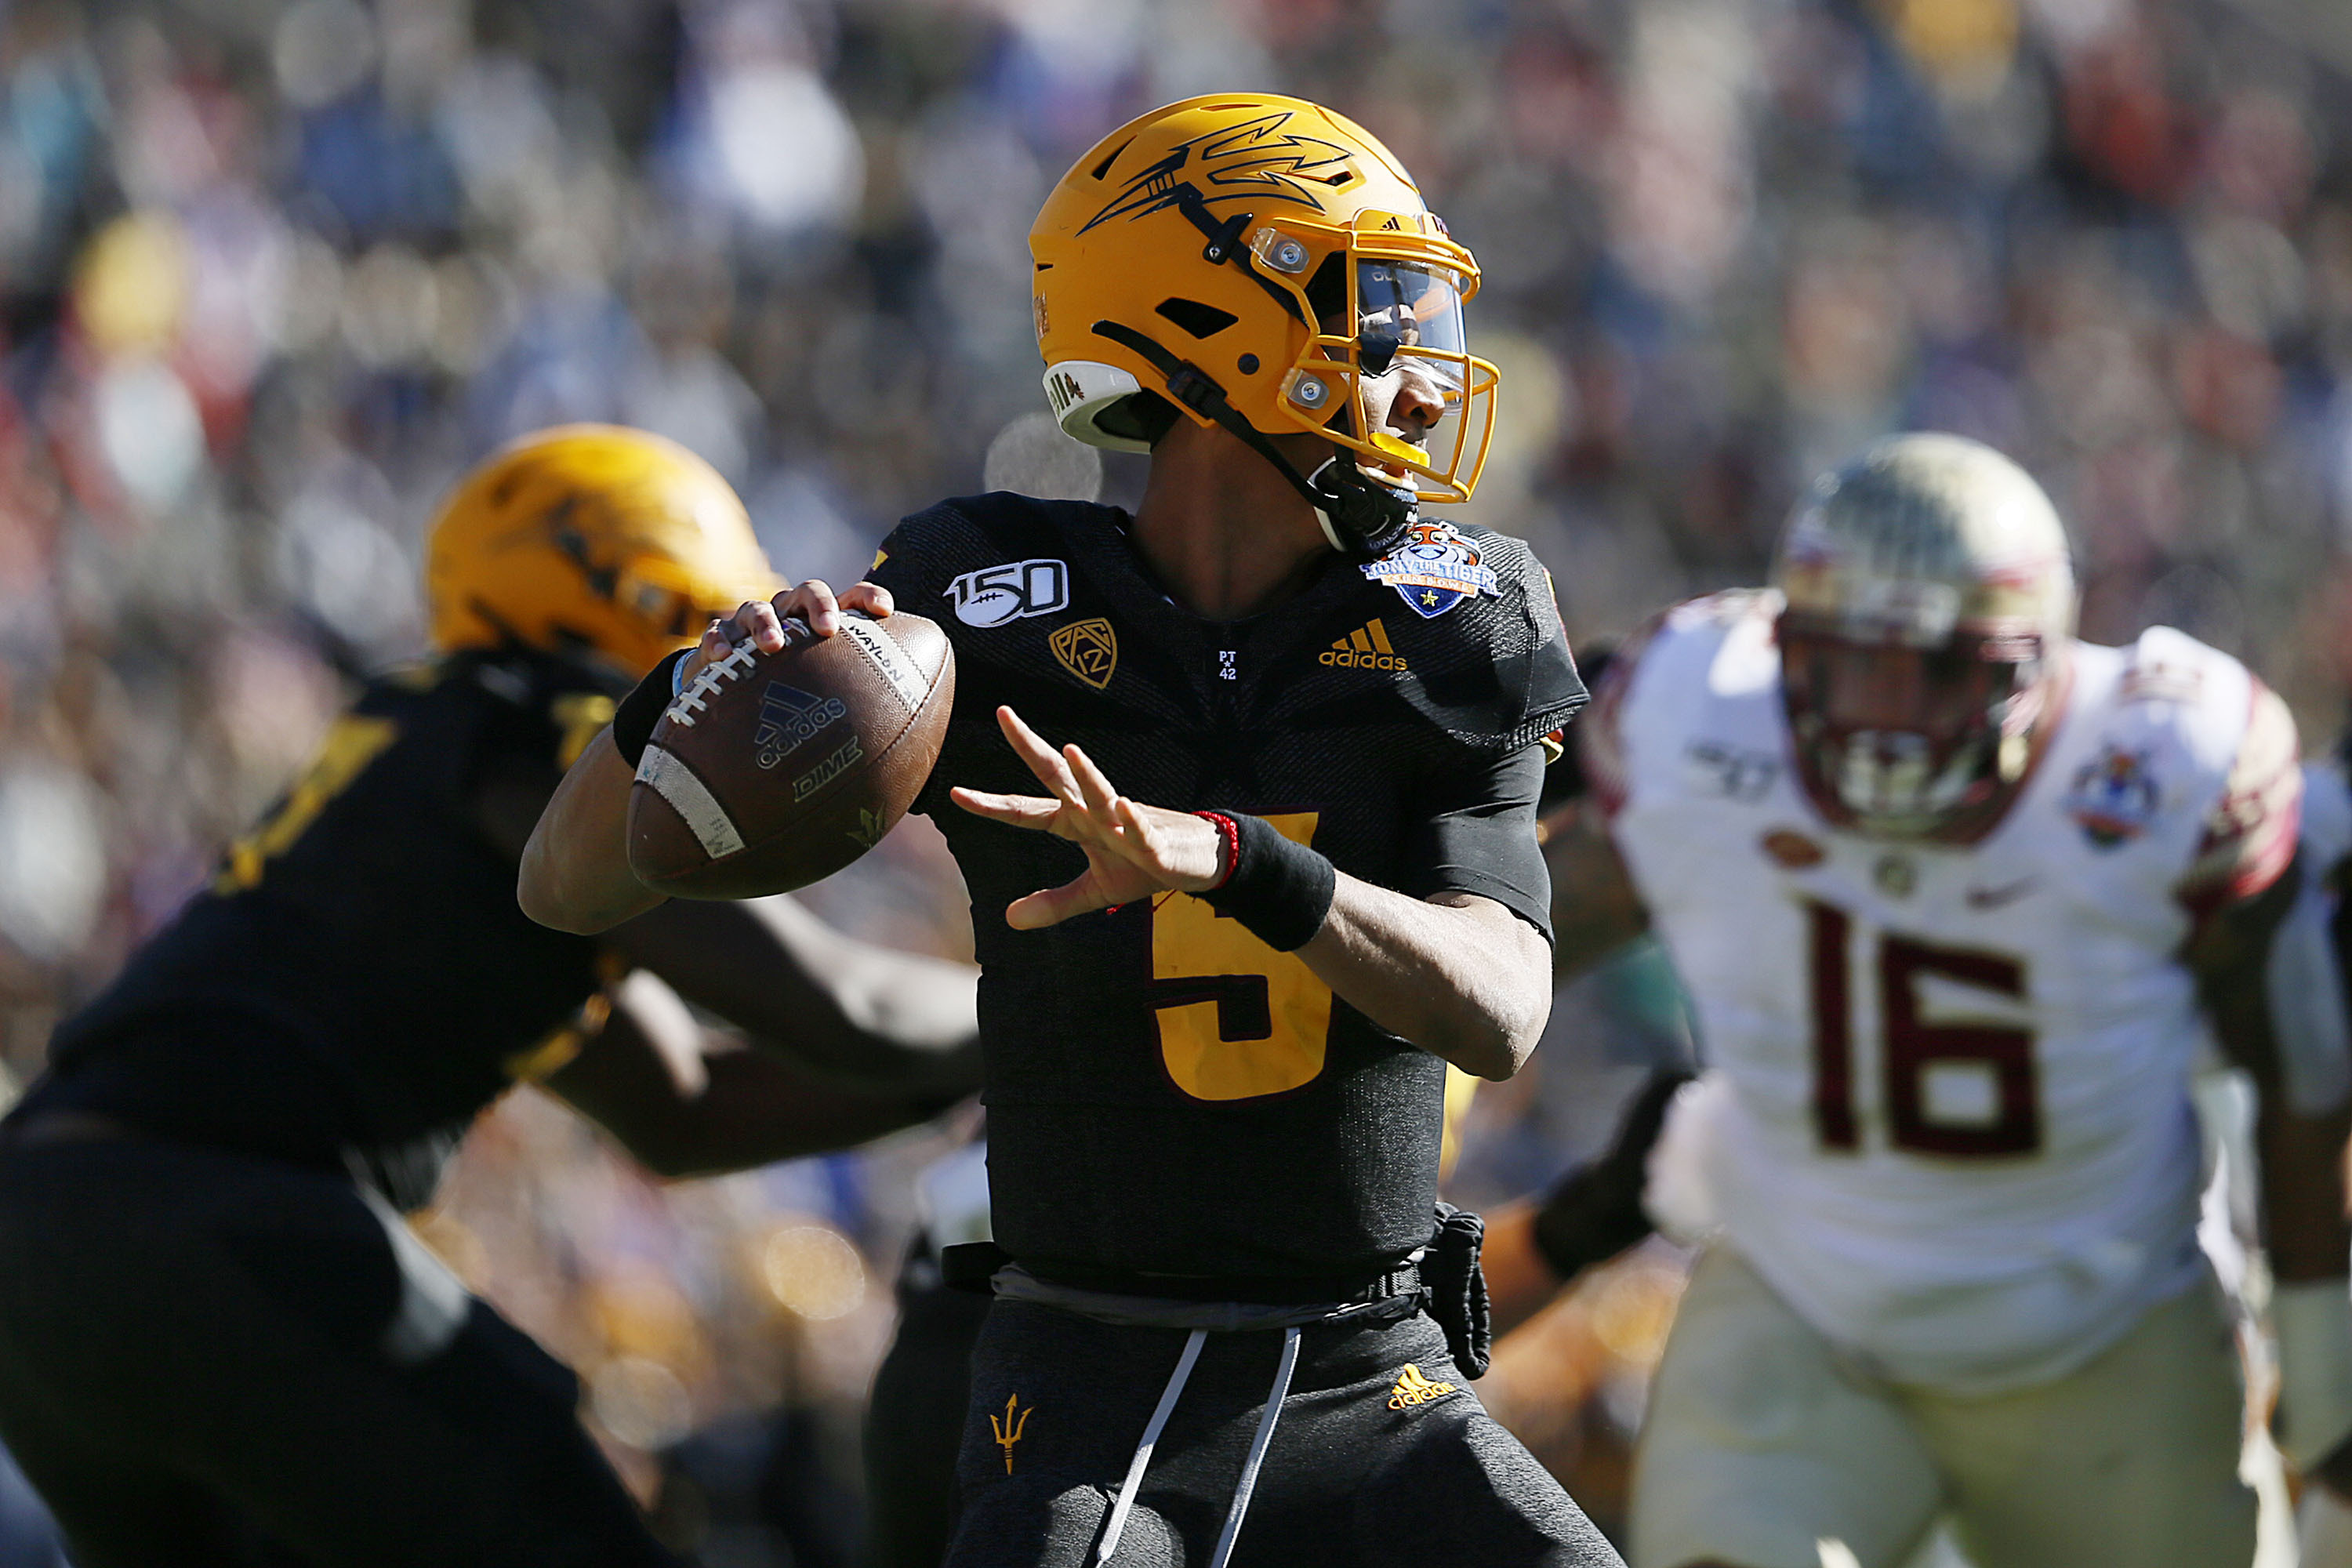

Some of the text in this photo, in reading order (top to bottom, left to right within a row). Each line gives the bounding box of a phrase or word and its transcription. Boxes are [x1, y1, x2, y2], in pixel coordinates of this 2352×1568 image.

[947, 560, 1065, 625] 150
[1392, 574, 1470, 591] SUN BOWL
[1416, 560, 1441, 572] THE
[1442, 563, 1496, 593] TIGER
[849, 626, 904, 681] WAYLON
[1058, 624, 1112, 665] PAC
[1076, 649, 1109, 675] 12
[1219, 651, 1236, 662] PT
[1319, 650, 1408, 671] adidas
[1219, 668, 1236, 680] 42
[756, 698, 847, 770] adidas
[792, 734, 863, 803] DIME
[1151, 811, 1332, 1101] 5
[1805, 896, 2043, 1160] 16
[1388, 1381, 1457, 1410] adidas
